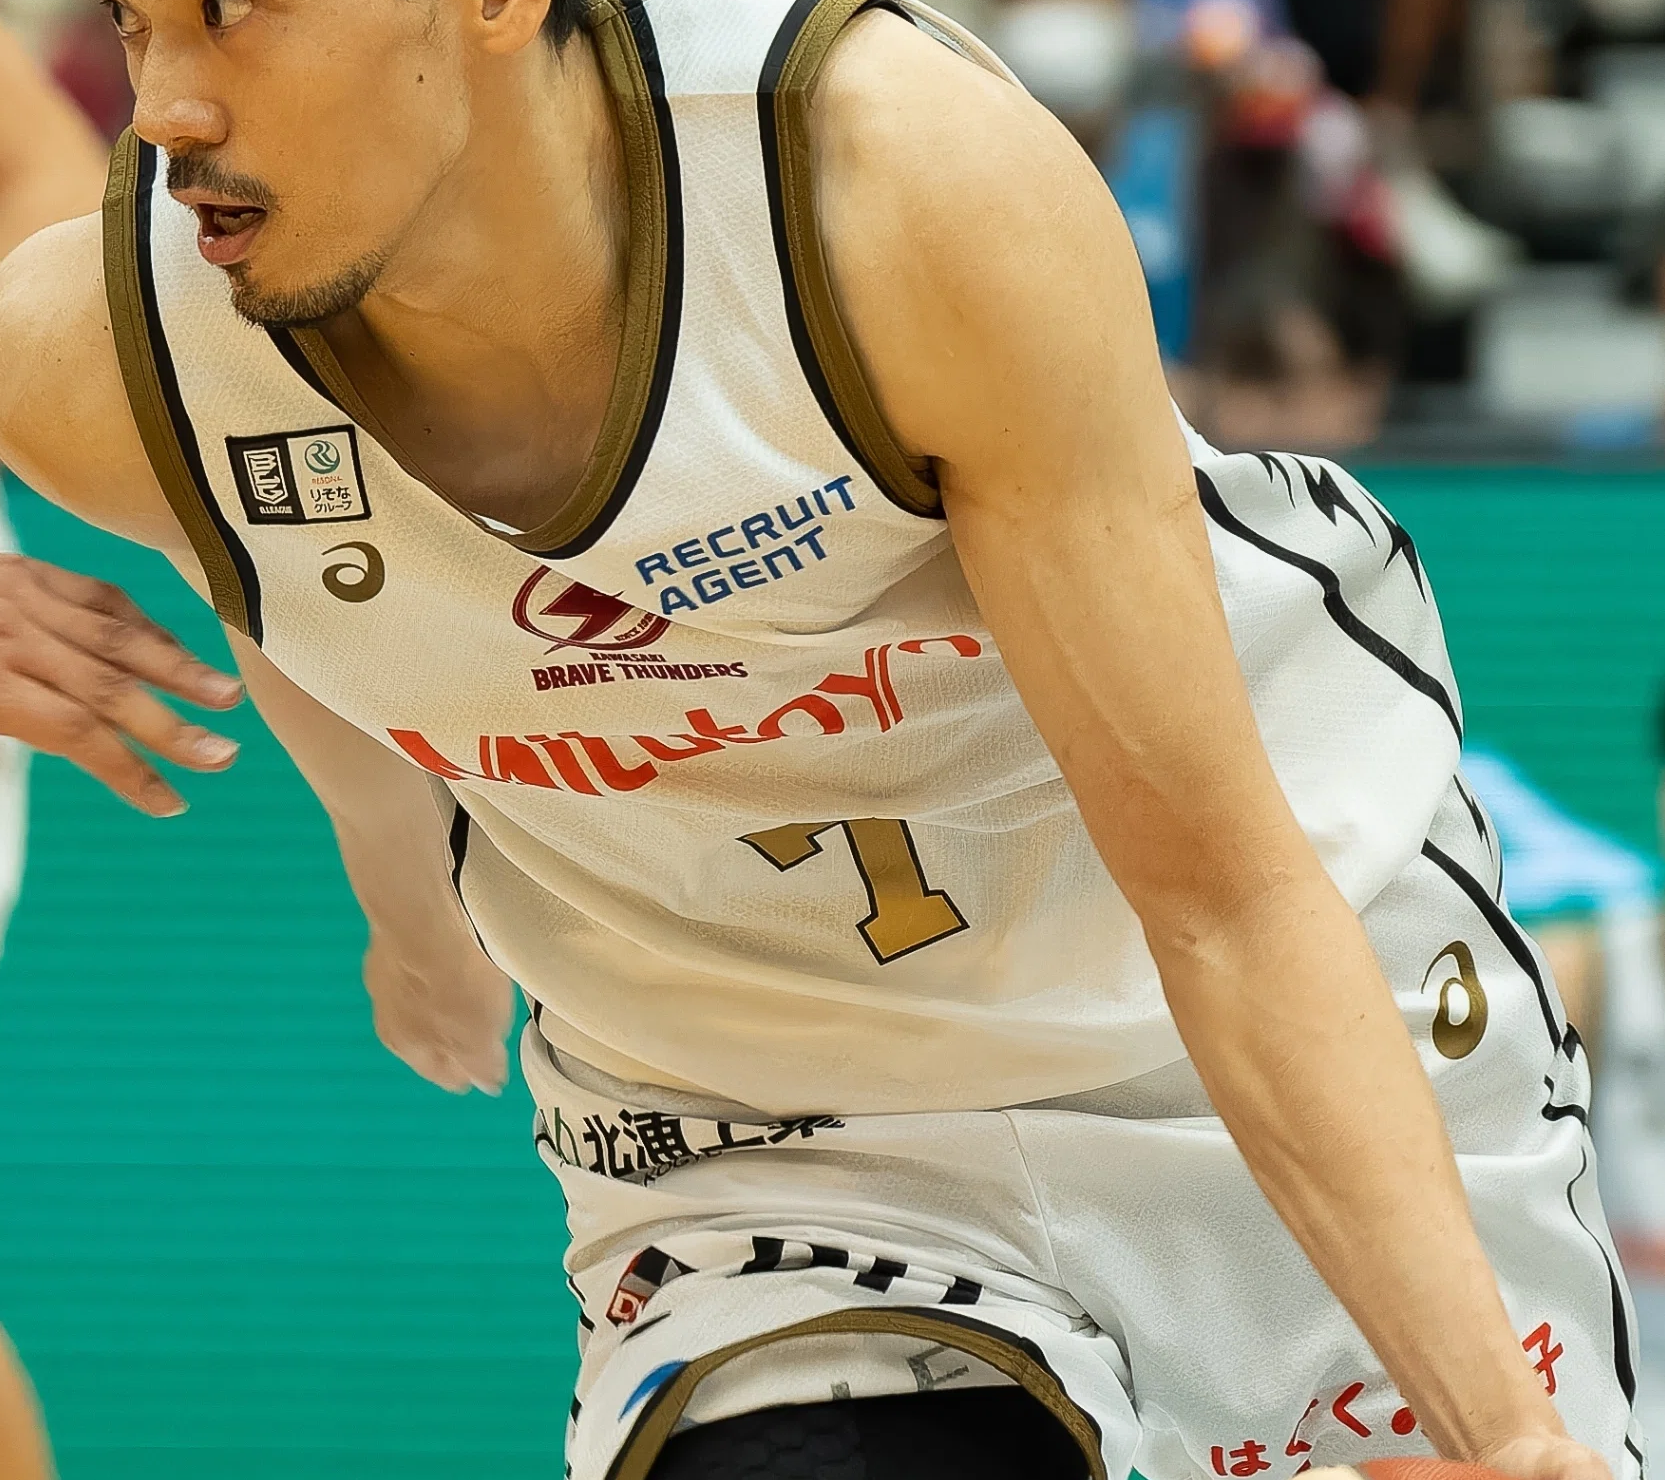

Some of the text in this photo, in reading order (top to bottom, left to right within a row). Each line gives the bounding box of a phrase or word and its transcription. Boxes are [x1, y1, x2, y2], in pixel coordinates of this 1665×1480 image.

[310, 486, 352, 502] りそな
[634, 475, 856, 588] RECRUIT
[658, 525, 832, 616] AGENT
[531, 662, 749, 692] BRAVE THUNDERS
[589, 652, 666, 663] KAWASAKI
[736, 816, 970, 967] 7
